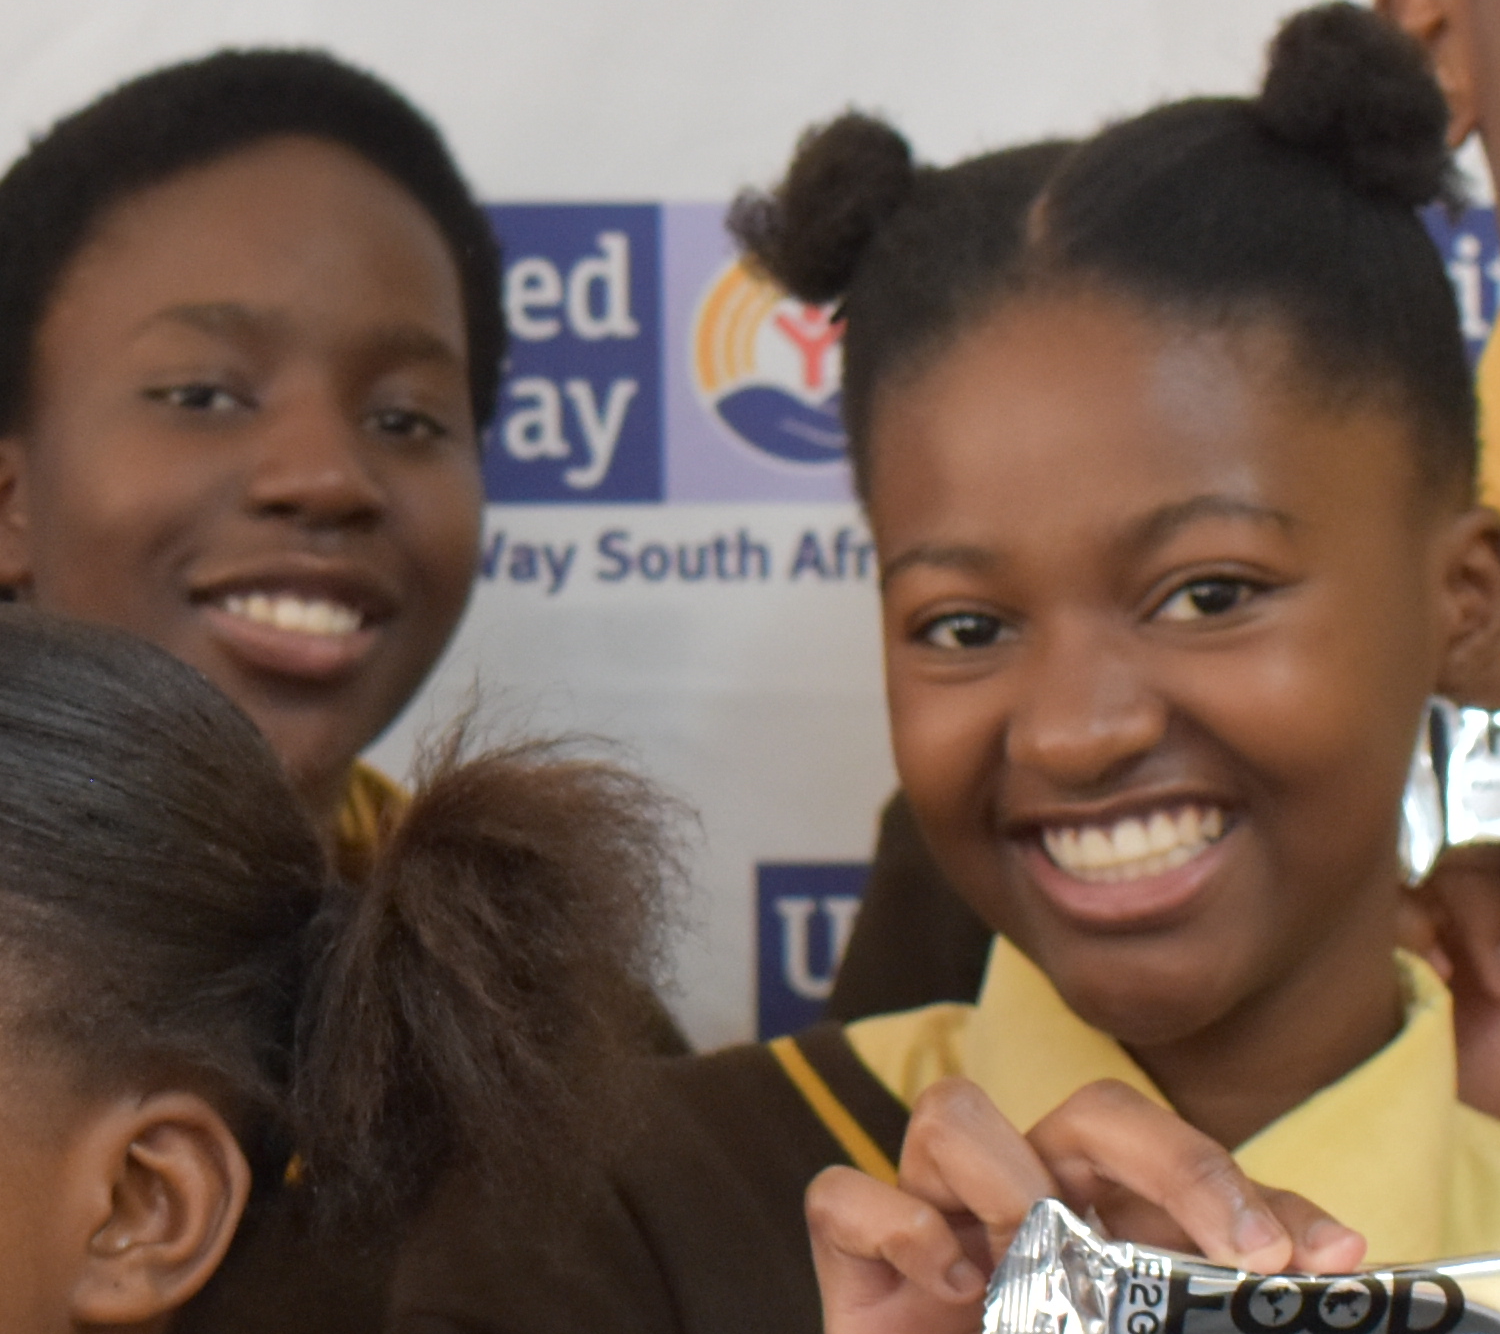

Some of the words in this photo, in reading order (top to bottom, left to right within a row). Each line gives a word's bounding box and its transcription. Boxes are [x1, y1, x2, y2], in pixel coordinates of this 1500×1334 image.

[504, 377, 639, 488] ay
[596, 529, 769, 584] South
[790, 532, 873, 584] Afr
